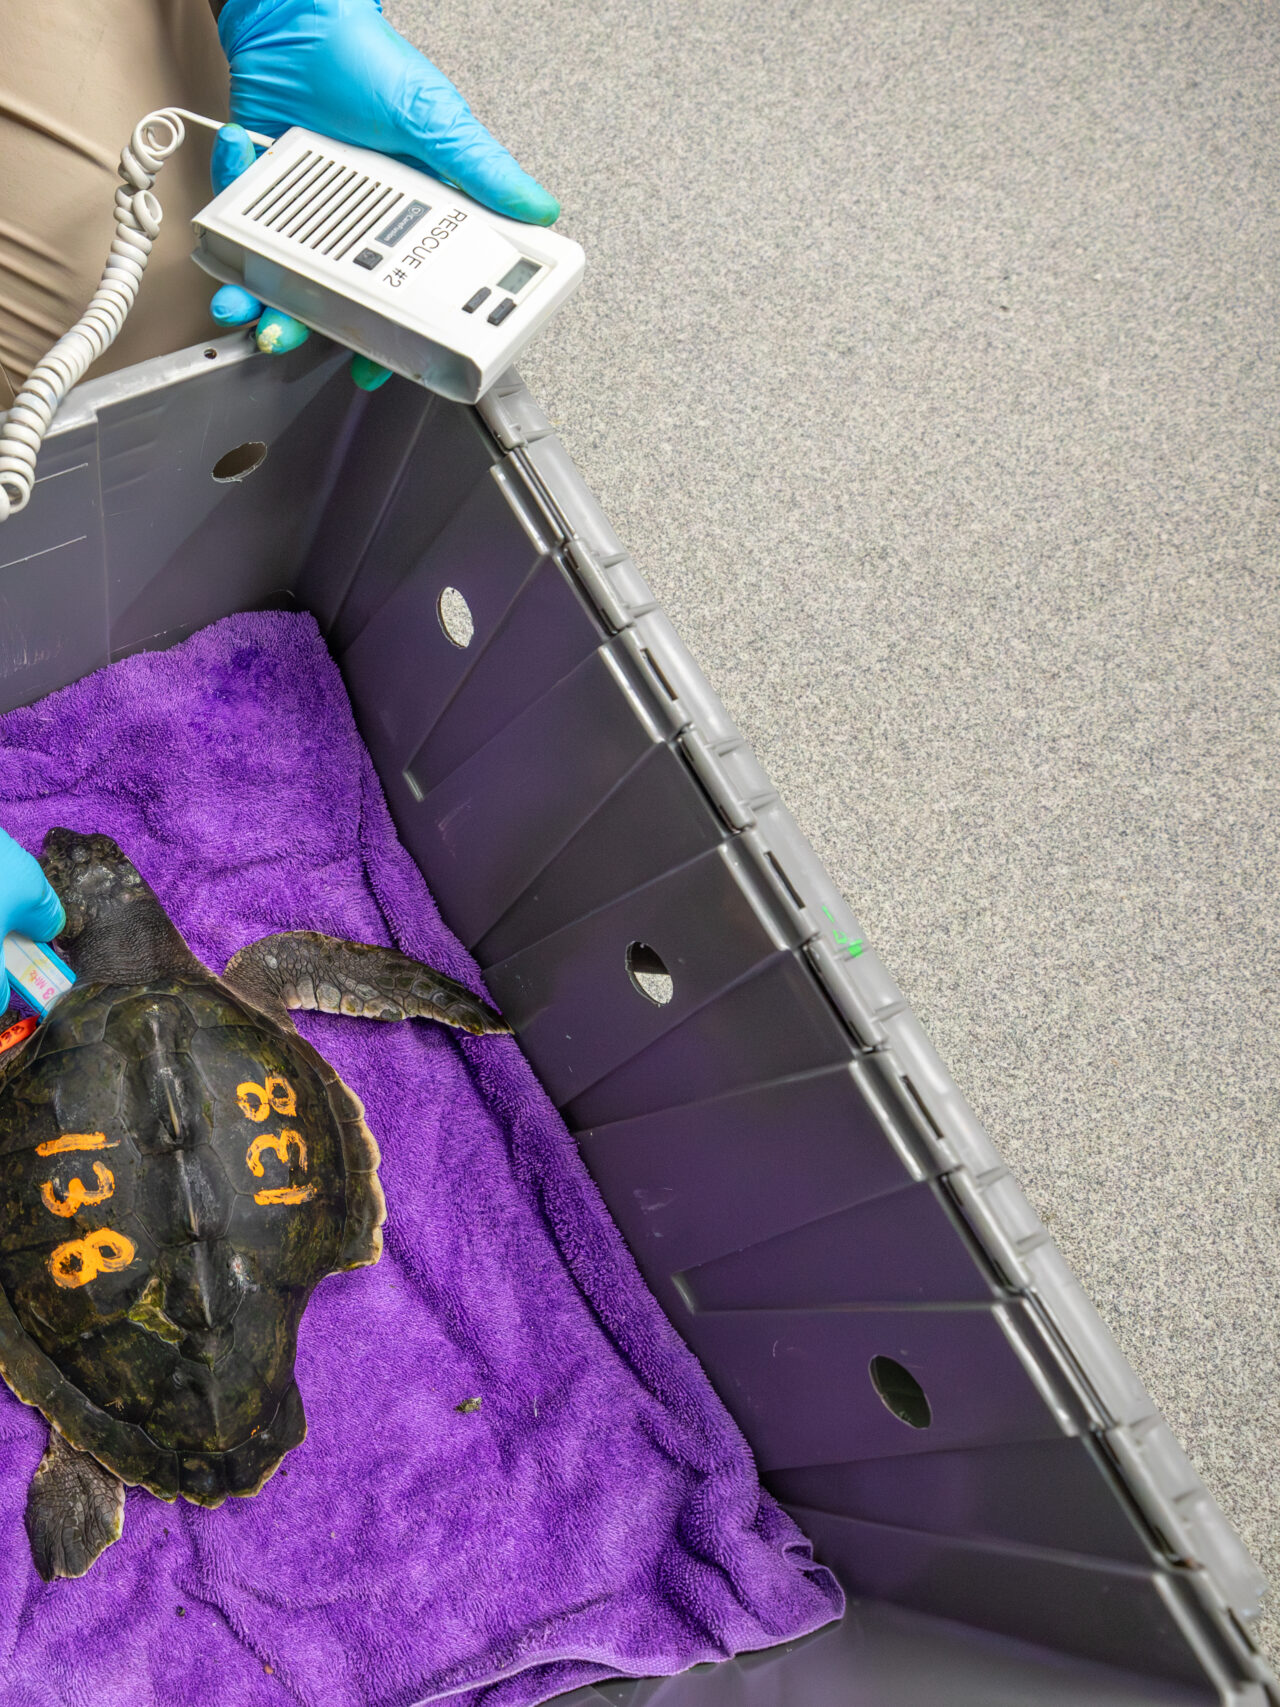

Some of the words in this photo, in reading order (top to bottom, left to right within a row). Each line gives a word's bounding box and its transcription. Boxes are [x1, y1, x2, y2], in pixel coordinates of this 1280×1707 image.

[402, 208, 468, 269] RESCUE
[382, 267, 408, 288] #2
[42, 987, 55, 1000] 3
[236, 1071, 318, 1206] 138
[34, 1131, 138, 1289] 138
